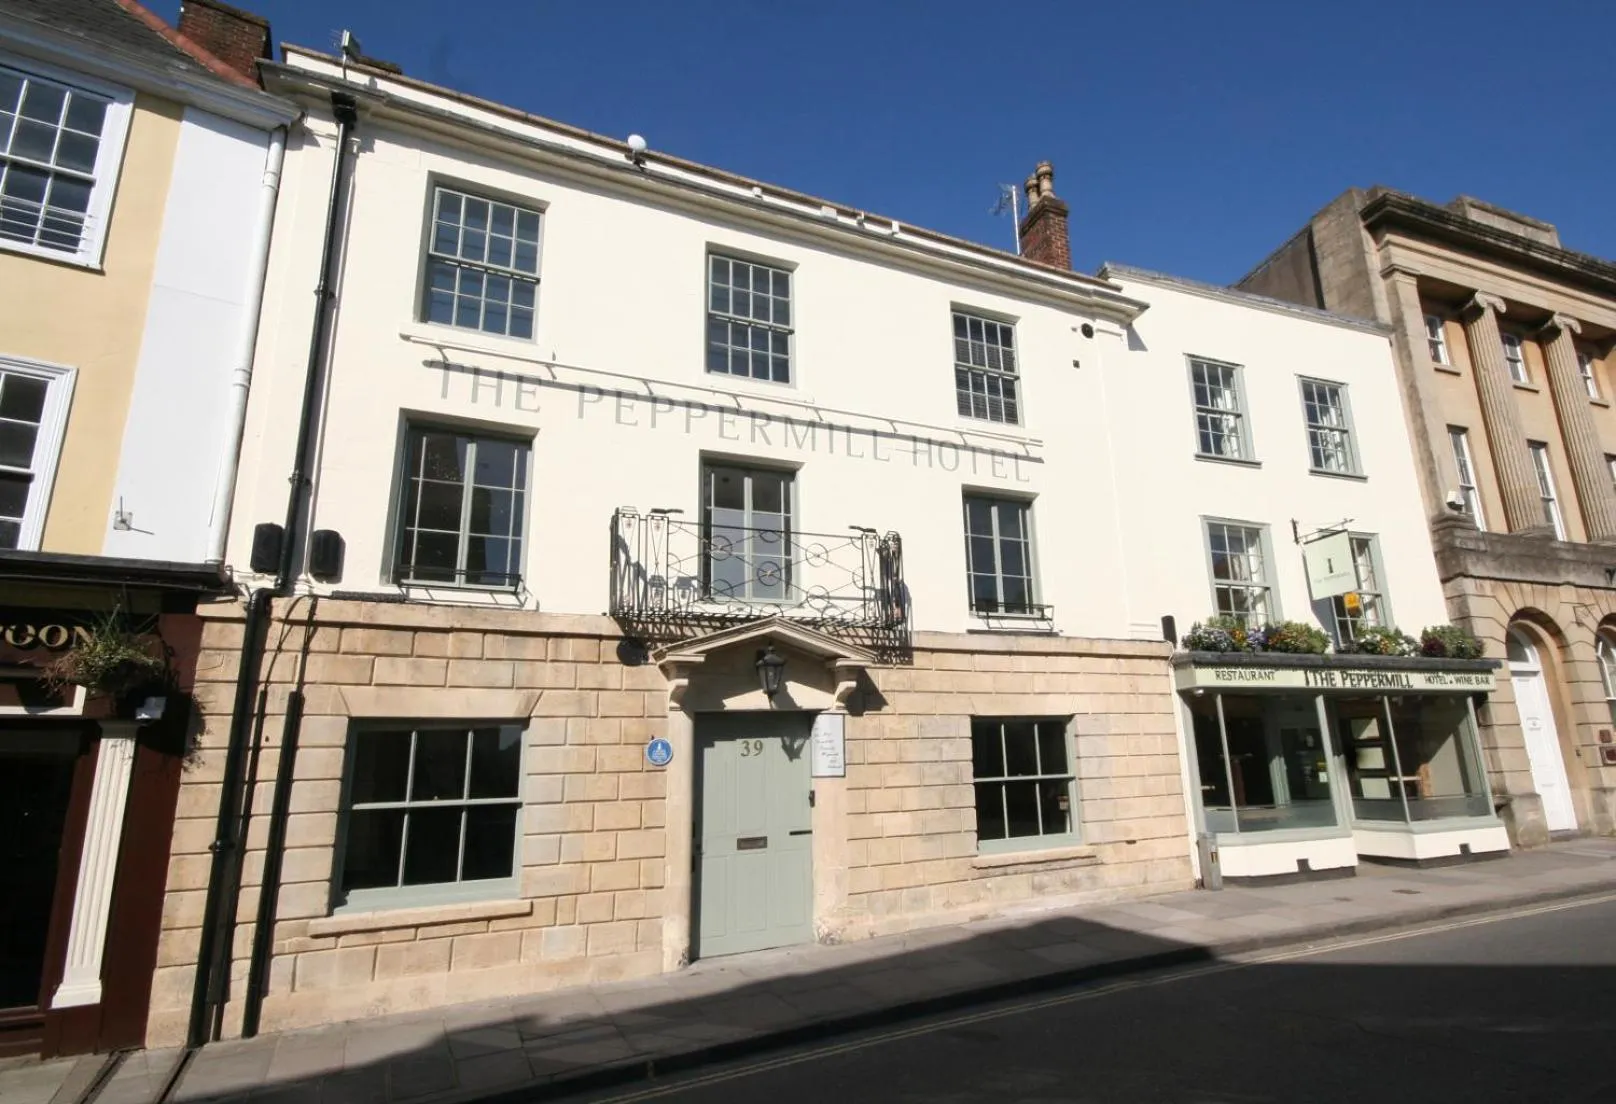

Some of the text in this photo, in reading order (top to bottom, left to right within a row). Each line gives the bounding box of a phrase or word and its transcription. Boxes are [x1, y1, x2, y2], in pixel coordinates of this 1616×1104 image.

[433, 360, 1031, 483] THE PEPPERMILL HOTEL
[0, 624, 95, 648] OON
[1215, 670, 1276, 681] RESTAURANT
[1310, 670, 1413, 688] THE PEPPERMILL
[1424, 675, 1490, 685] HOTEL WINE BAR
[740, 740, 764, 757] 39
